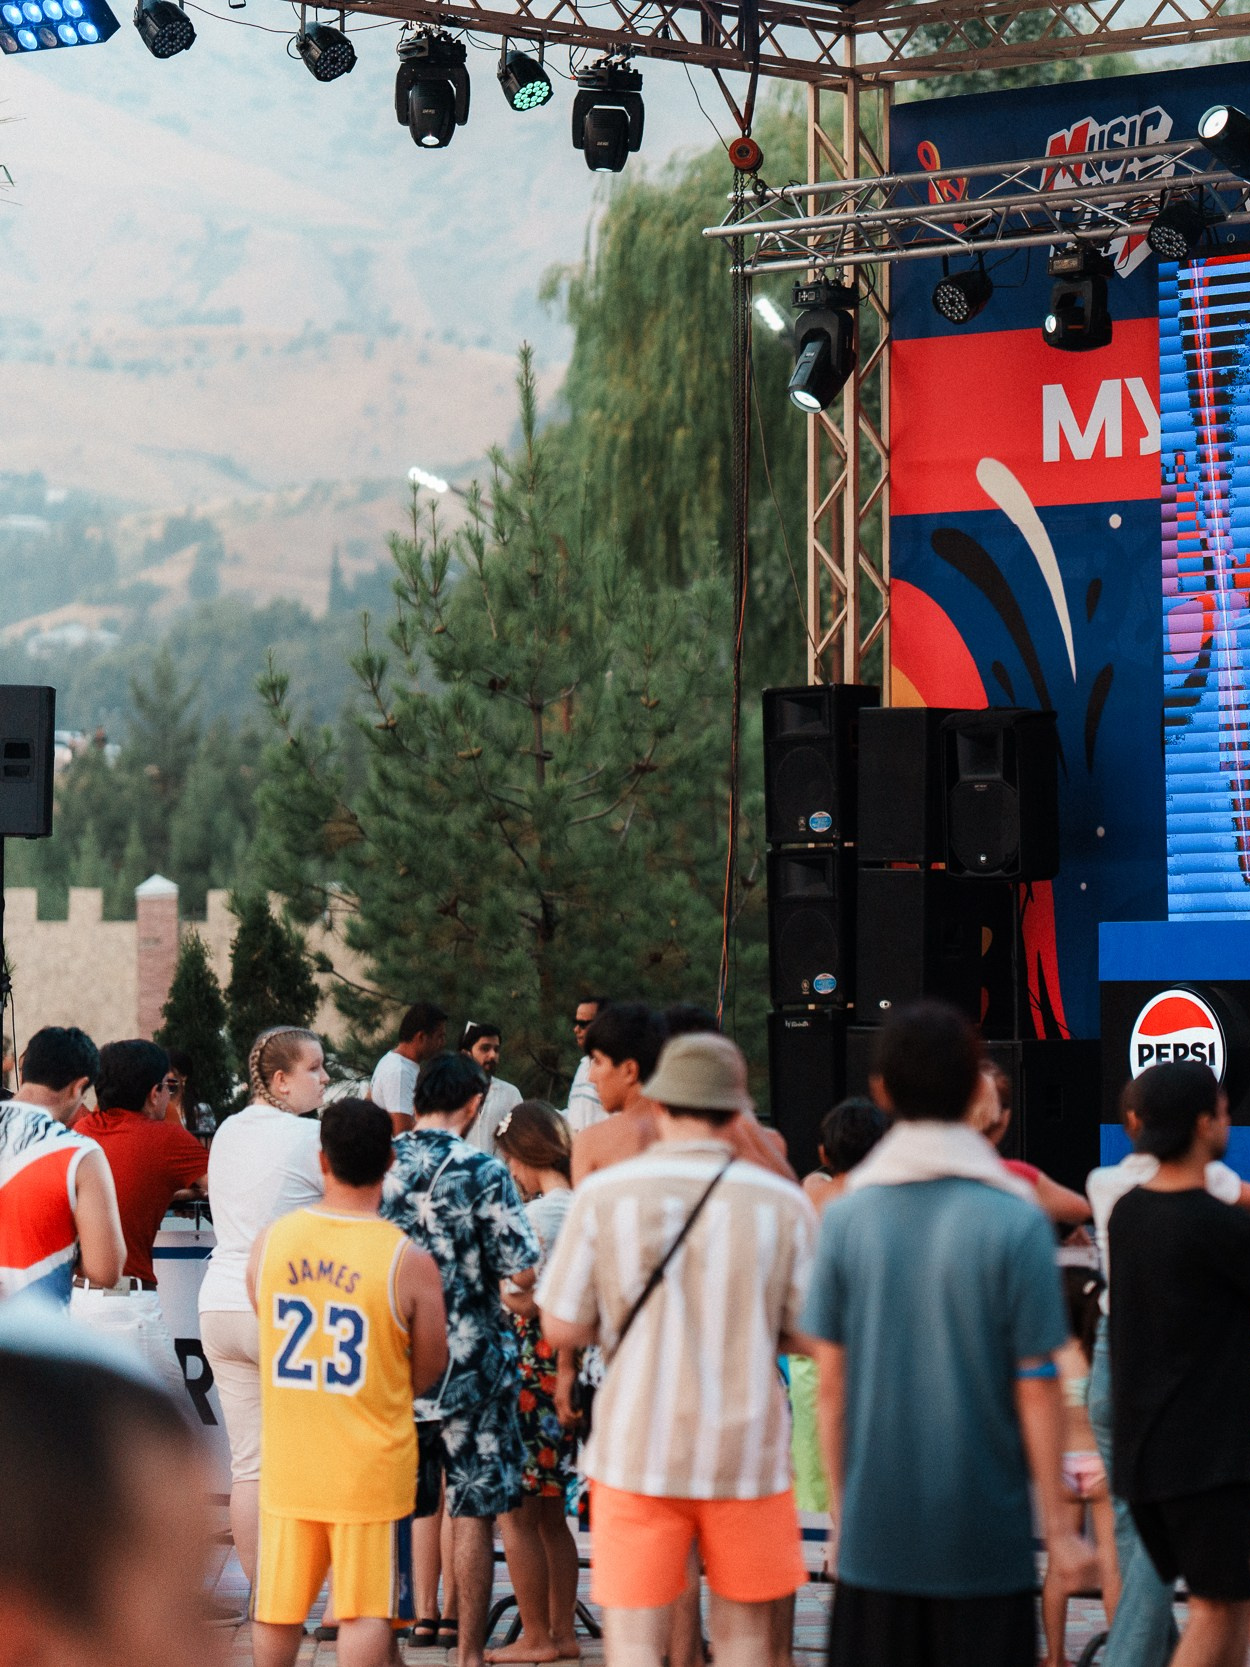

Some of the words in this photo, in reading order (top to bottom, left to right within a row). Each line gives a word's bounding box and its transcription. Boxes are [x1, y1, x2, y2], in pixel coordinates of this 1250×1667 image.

[1043, 108, 1172, 192] MUSIC
[1137, 1041, 1216, 1068] PEPSI
[288, 1258, 362, 1294] JAMES
[273, 1293, 370, 1396] 23
